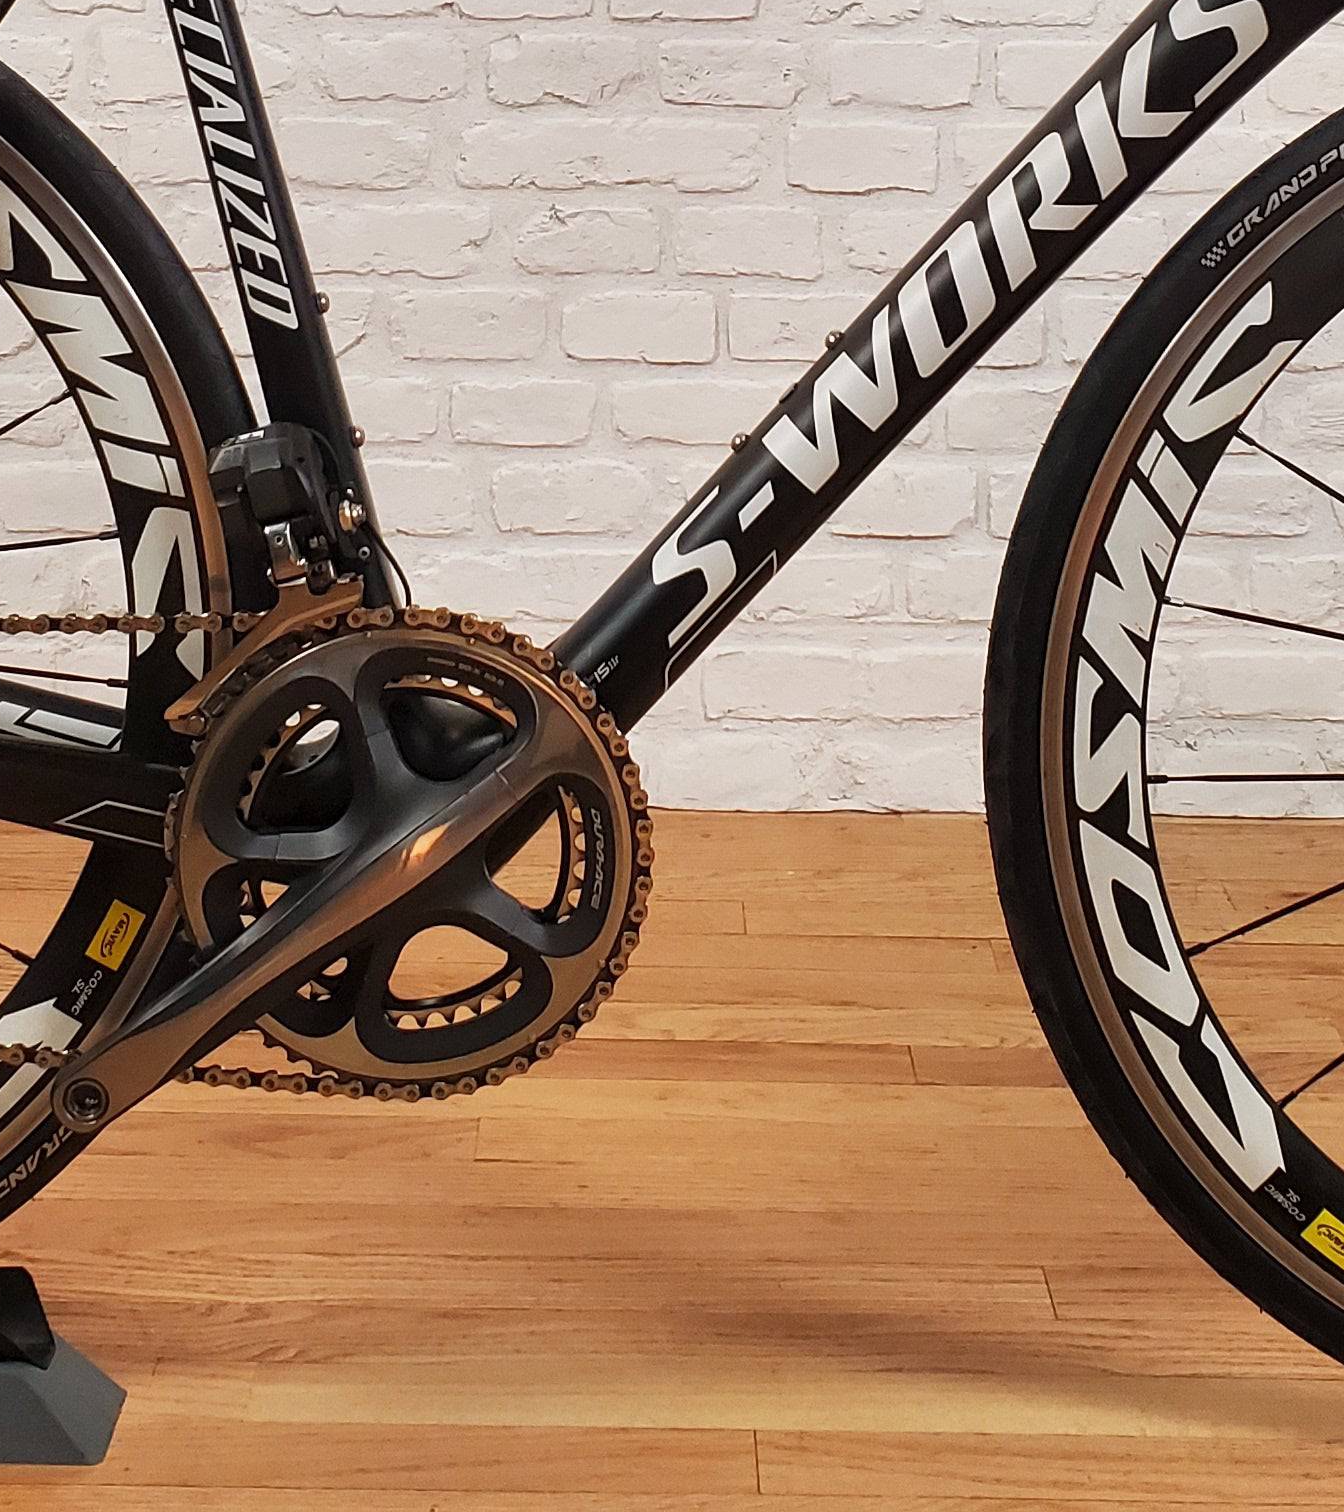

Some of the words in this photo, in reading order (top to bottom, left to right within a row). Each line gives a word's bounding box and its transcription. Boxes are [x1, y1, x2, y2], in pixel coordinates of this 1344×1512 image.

[1226, 163, 1318, 248] GRAND
[590, 807, 605, 910] DURA-ACE
[71, 978, 85, 995] SL
[71, 970, 103, 1015] COSMIC
[1264, 1183, 1307, 1222] COSMIC
[1286, 1188, 1301, 1204] SL
